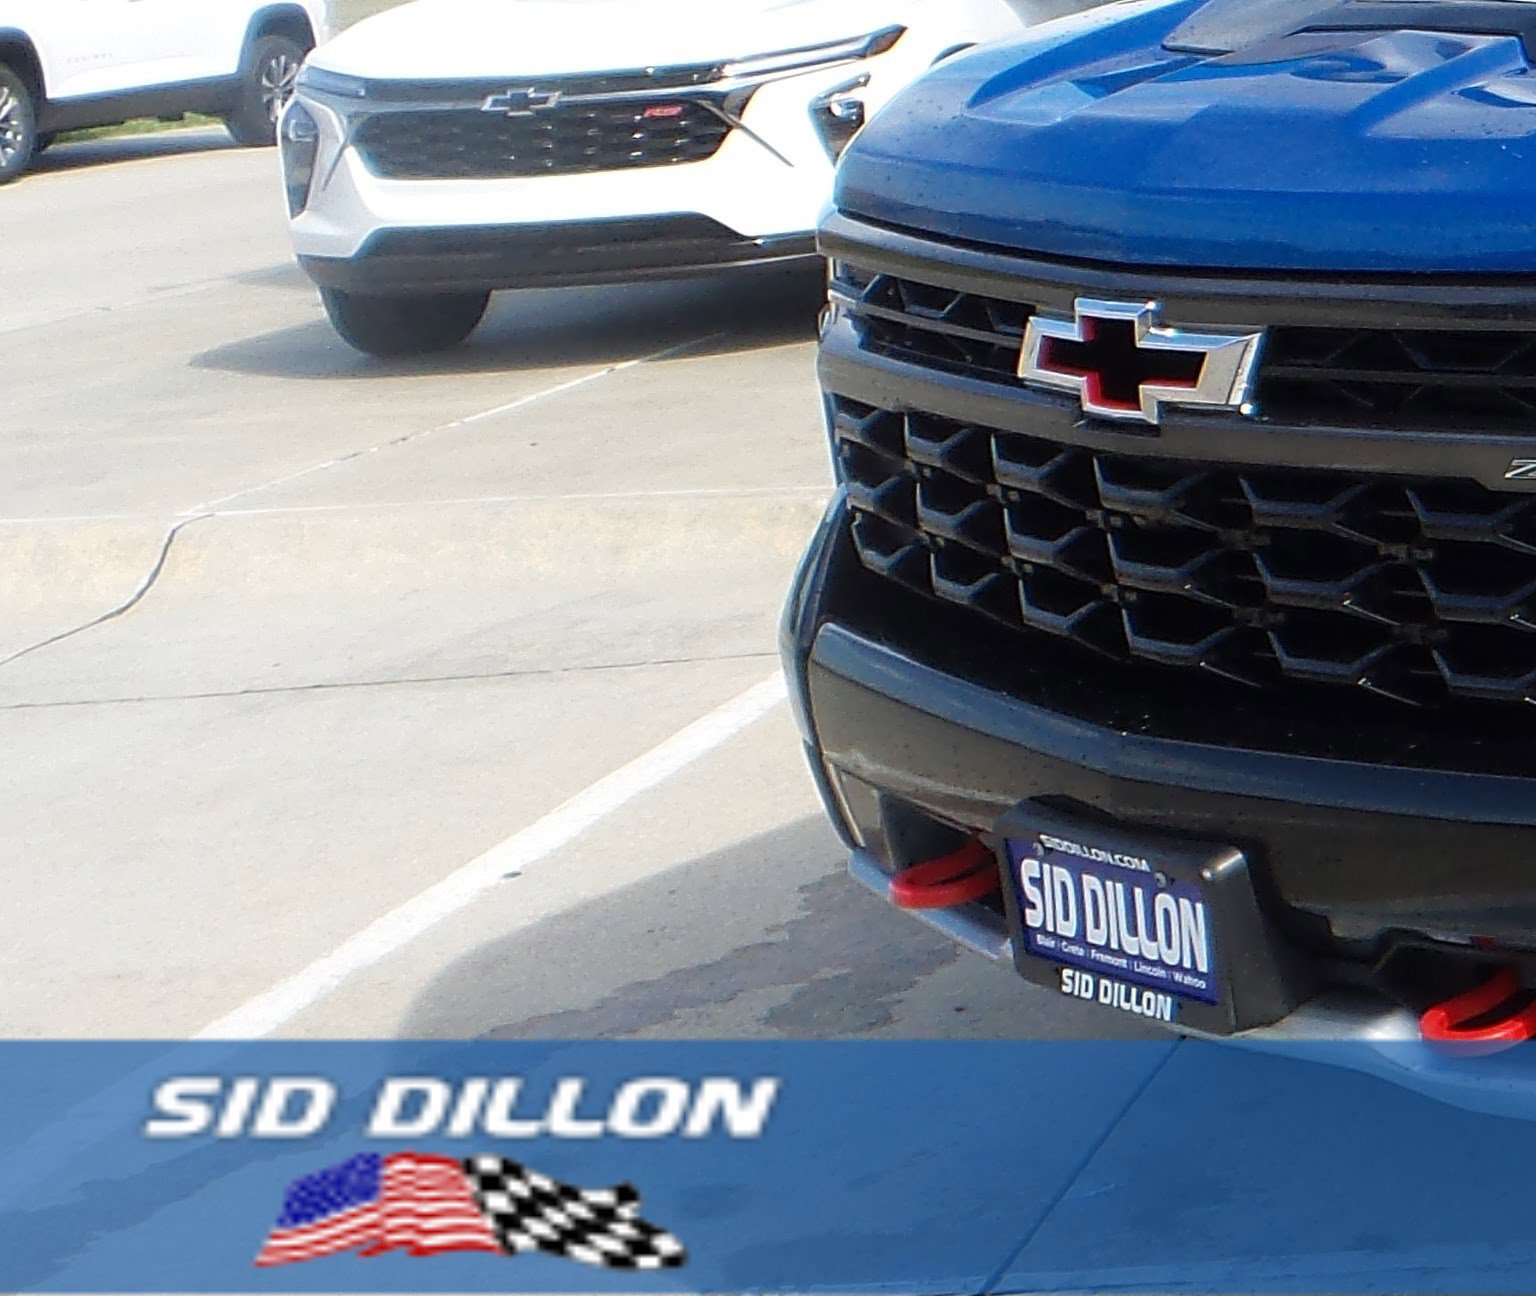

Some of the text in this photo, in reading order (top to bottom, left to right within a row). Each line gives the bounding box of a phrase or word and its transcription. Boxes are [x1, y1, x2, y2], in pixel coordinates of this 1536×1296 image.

[1020, 858, 1208, 974] SID DILLON
[1060, 967, 1172, 1022] SID DILLON
